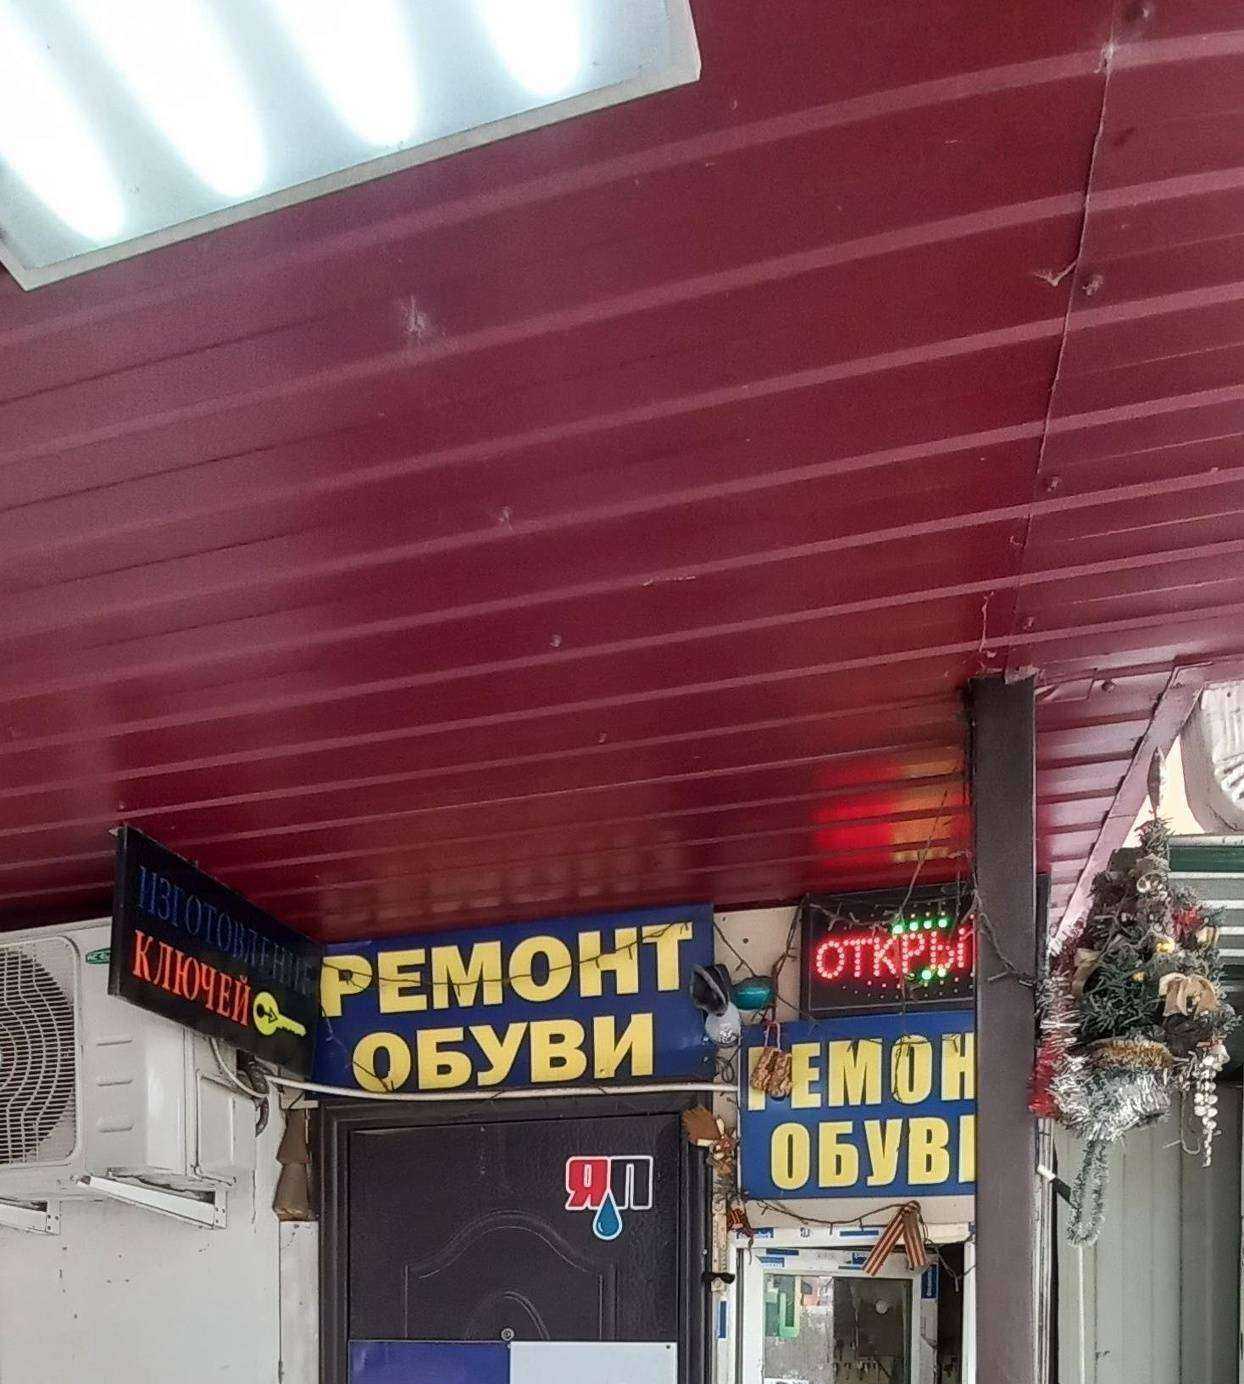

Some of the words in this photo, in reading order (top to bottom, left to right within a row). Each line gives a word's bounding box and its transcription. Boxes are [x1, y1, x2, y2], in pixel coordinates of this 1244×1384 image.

[132, 929, 252, 1026] КЛЮЧЕЙ
[319, 921, 694, 1018] РЕМОНТ
[352, 1013, 655, 1093] ОБУВИ
